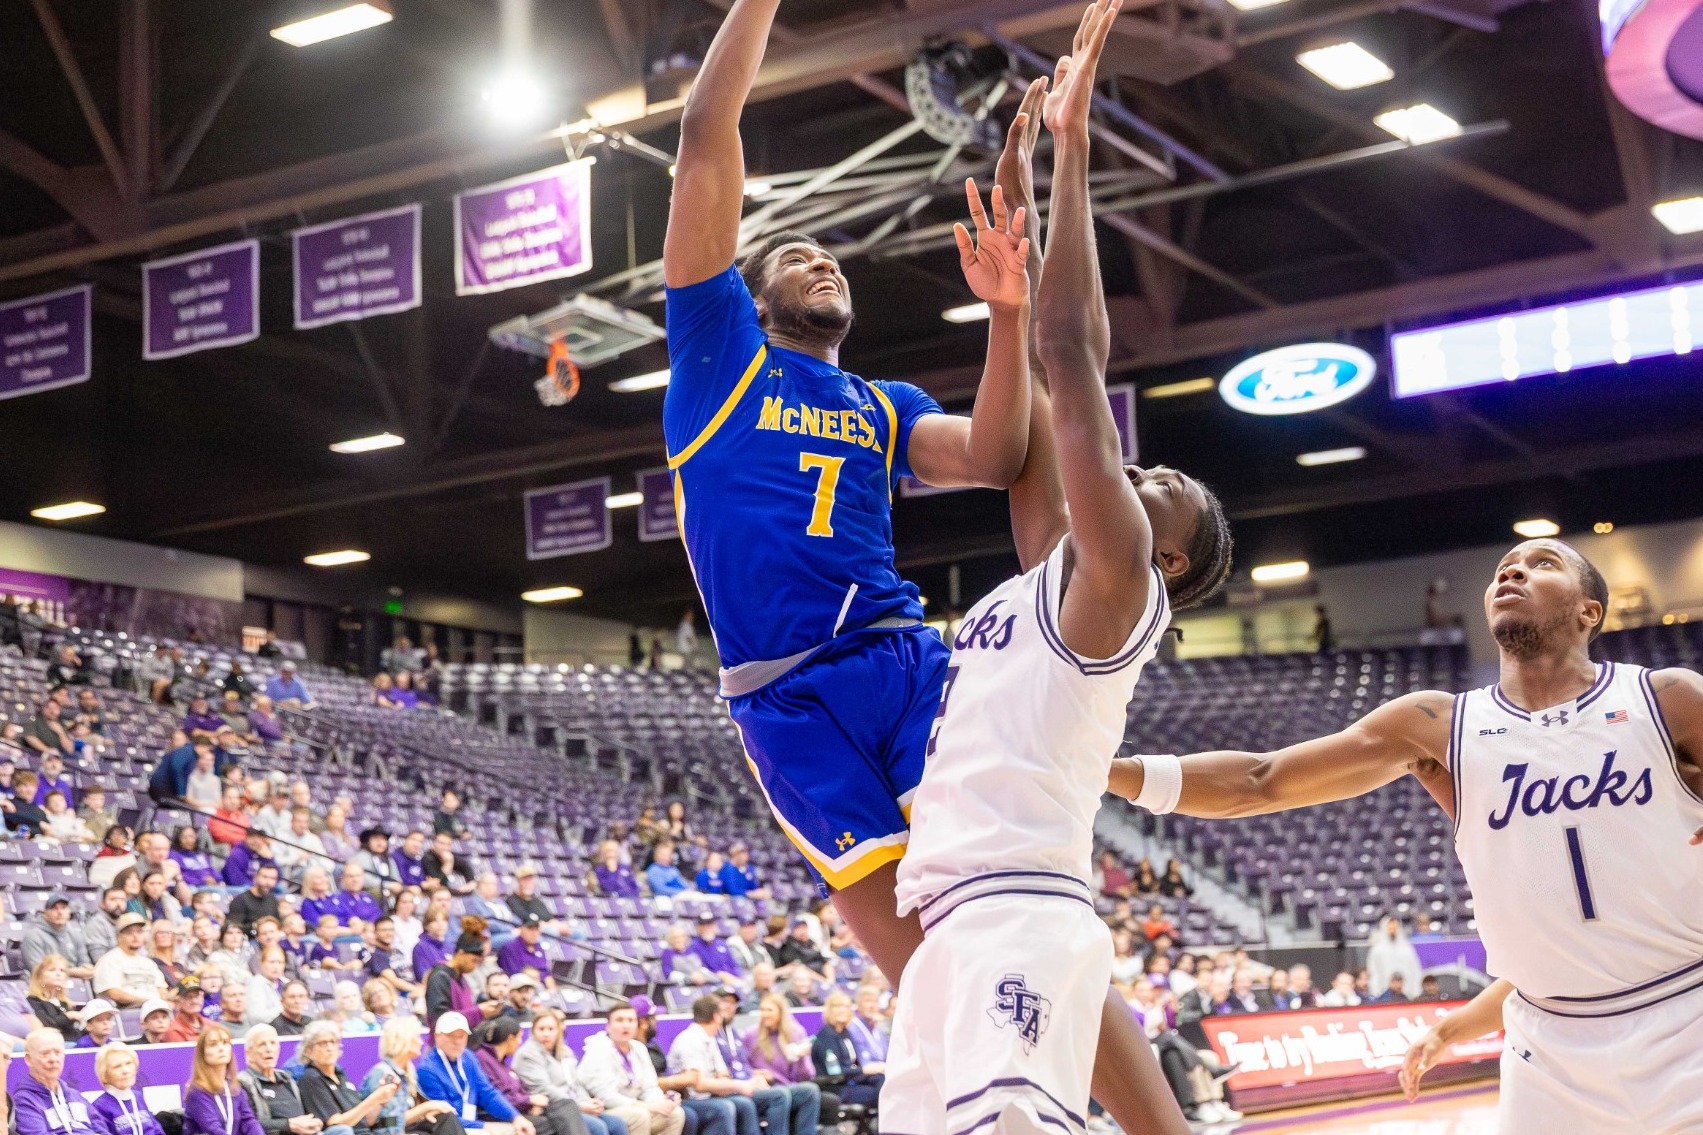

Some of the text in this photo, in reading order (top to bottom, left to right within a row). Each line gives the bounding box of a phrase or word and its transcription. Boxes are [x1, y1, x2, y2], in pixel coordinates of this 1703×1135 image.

[799, 452, 846, 537] 7
[1488, 750, 1653, 831] Jacks
[1562, 823, 1600, 924] 1
[996, 978, 1042, 1048] SFA
